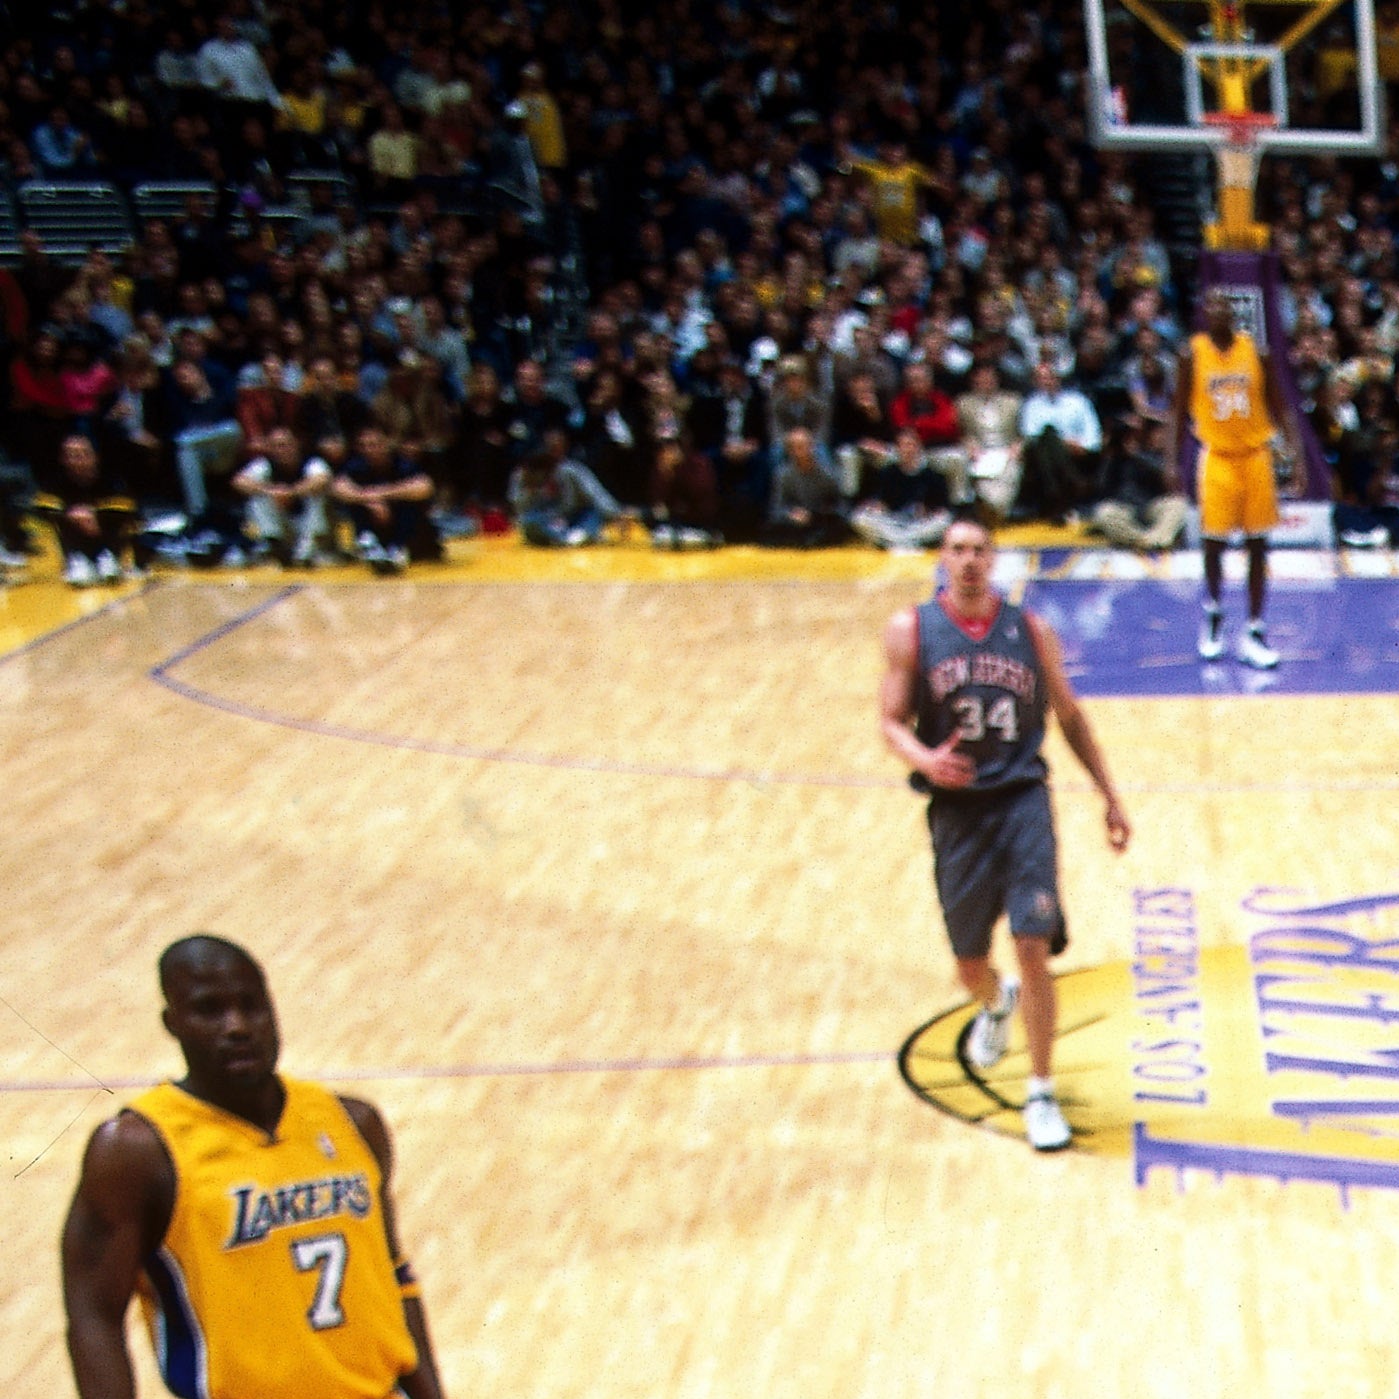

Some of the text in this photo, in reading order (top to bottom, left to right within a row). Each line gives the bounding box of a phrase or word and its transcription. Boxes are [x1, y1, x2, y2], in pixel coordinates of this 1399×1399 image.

[951, 695, 1020, 741] 34
[1133, 1038, 1206, 1106] LOS
[224, 1173, 372, 1252] LAKERS
[291, 1233, 349, 1331] 7
